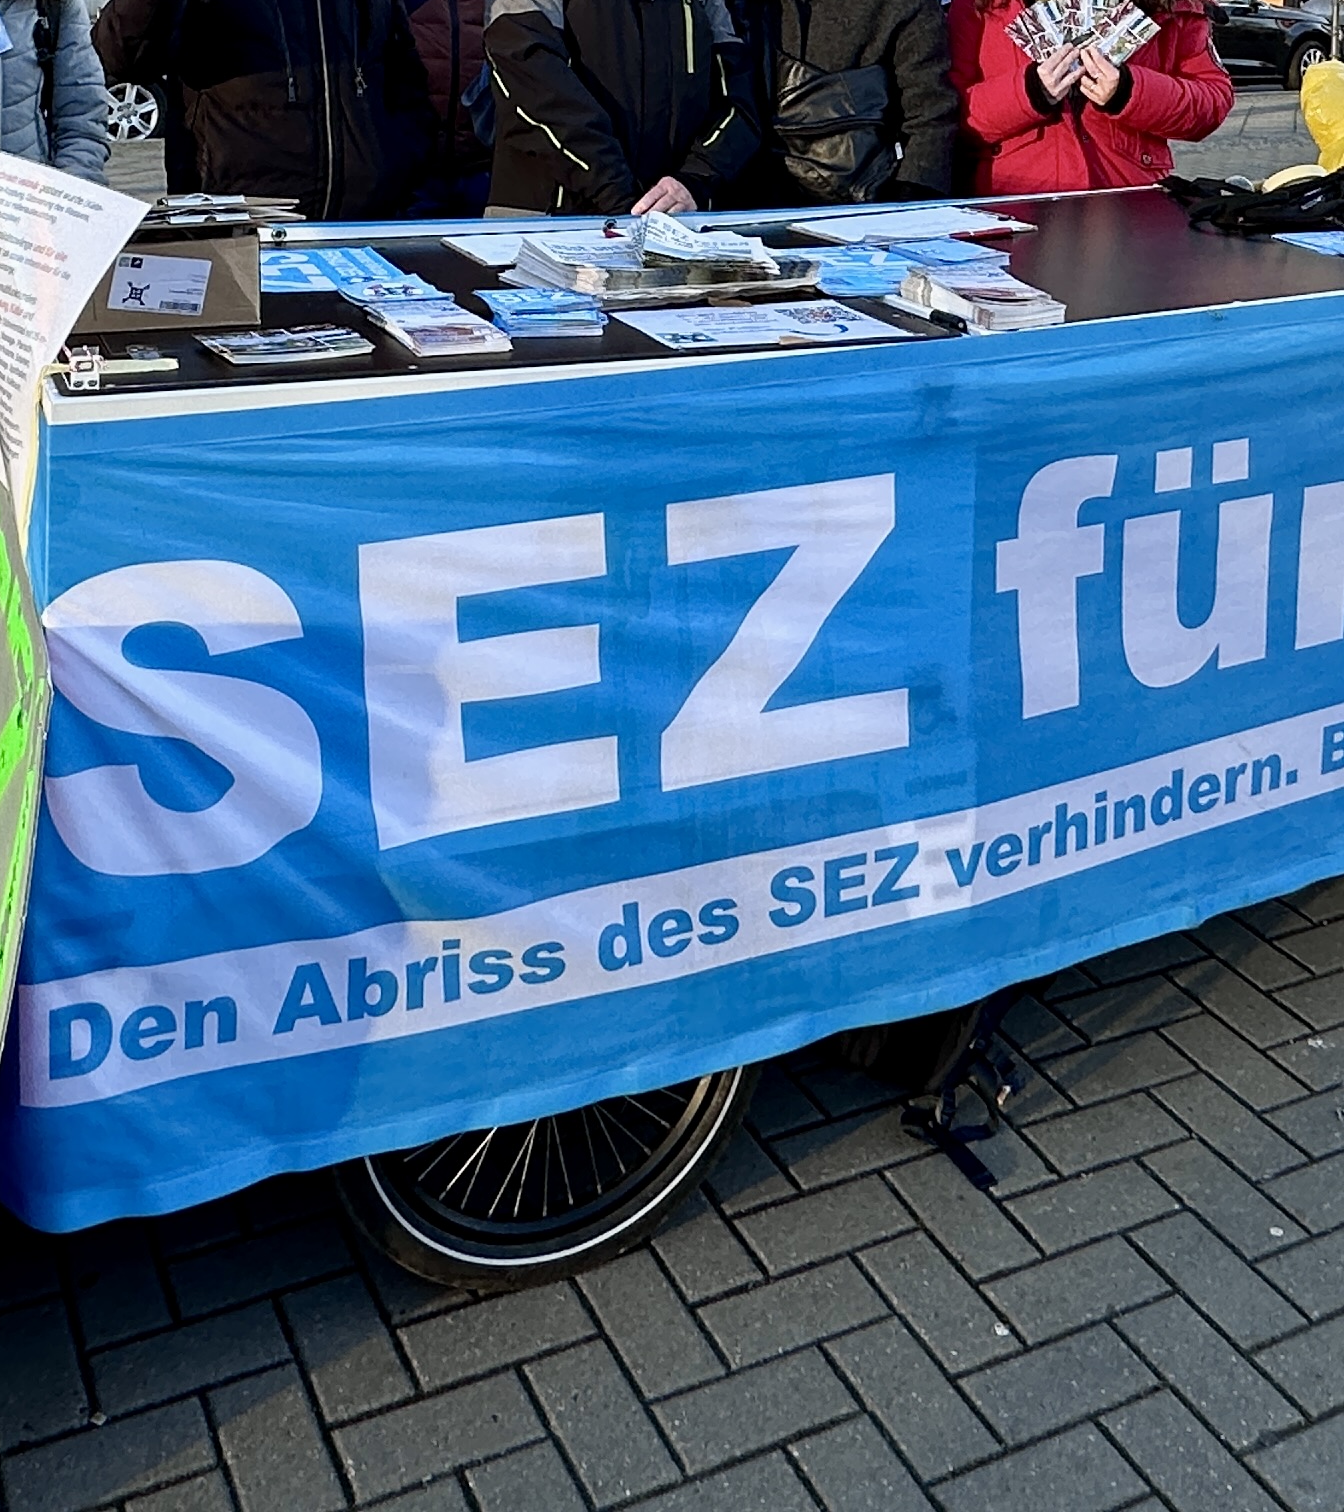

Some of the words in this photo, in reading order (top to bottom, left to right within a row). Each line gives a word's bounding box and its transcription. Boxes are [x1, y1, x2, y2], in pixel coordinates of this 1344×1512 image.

[43, 473, 910, 877] SEZ
[49, 992, 238, 1079] Den
[273, 939, 566, 1035] Abriss
[597, 894, 739, 972] des
[767, 841, 923, 929] SEZ
[944, 752, 1299, 889] verhindern.
